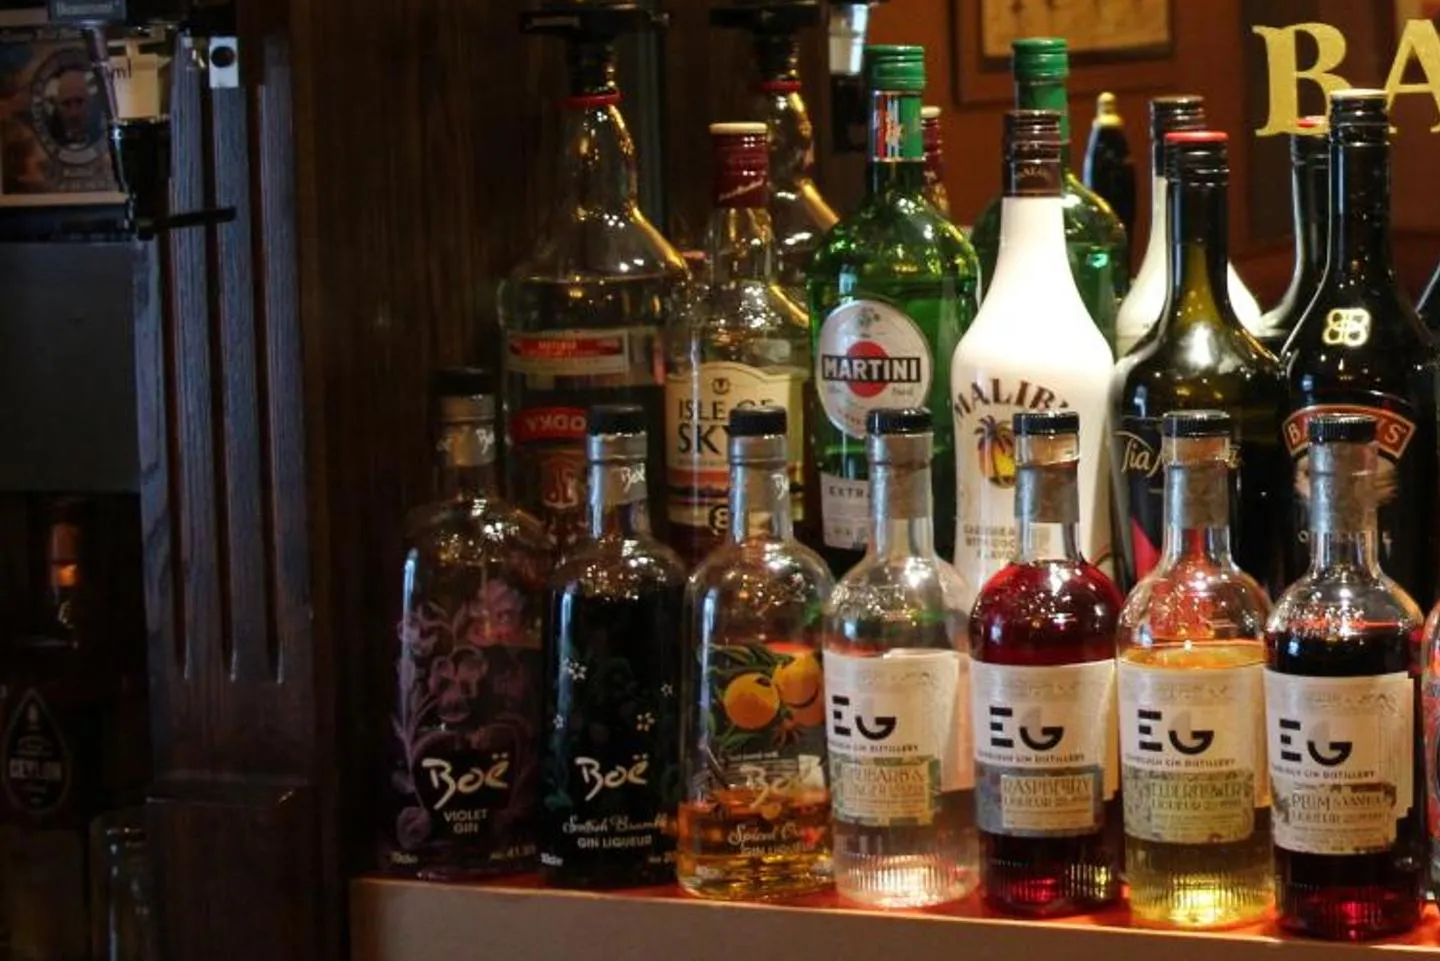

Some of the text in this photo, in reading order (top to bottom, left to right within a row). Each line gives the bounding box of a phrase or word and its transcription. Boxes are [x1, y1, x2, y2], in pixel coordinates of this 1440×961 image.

[823, 358, 919, 381] MARTINI
[954, 377, 1070, 420] MALIB
[677, 400, 726, 421] ISLE
[524, 413, 588, 432] ODKA
[677, 422, 732, 454] SK
[829, 485, 870, 500] EXTR
[421, 751, 511, 812] Boë
[573, 752, 650, 802] Boë
[442, 807, 489, 823] VIOLET
[453, 822, 480, 835] GIN
[577, 837, 600, 851] GIN
